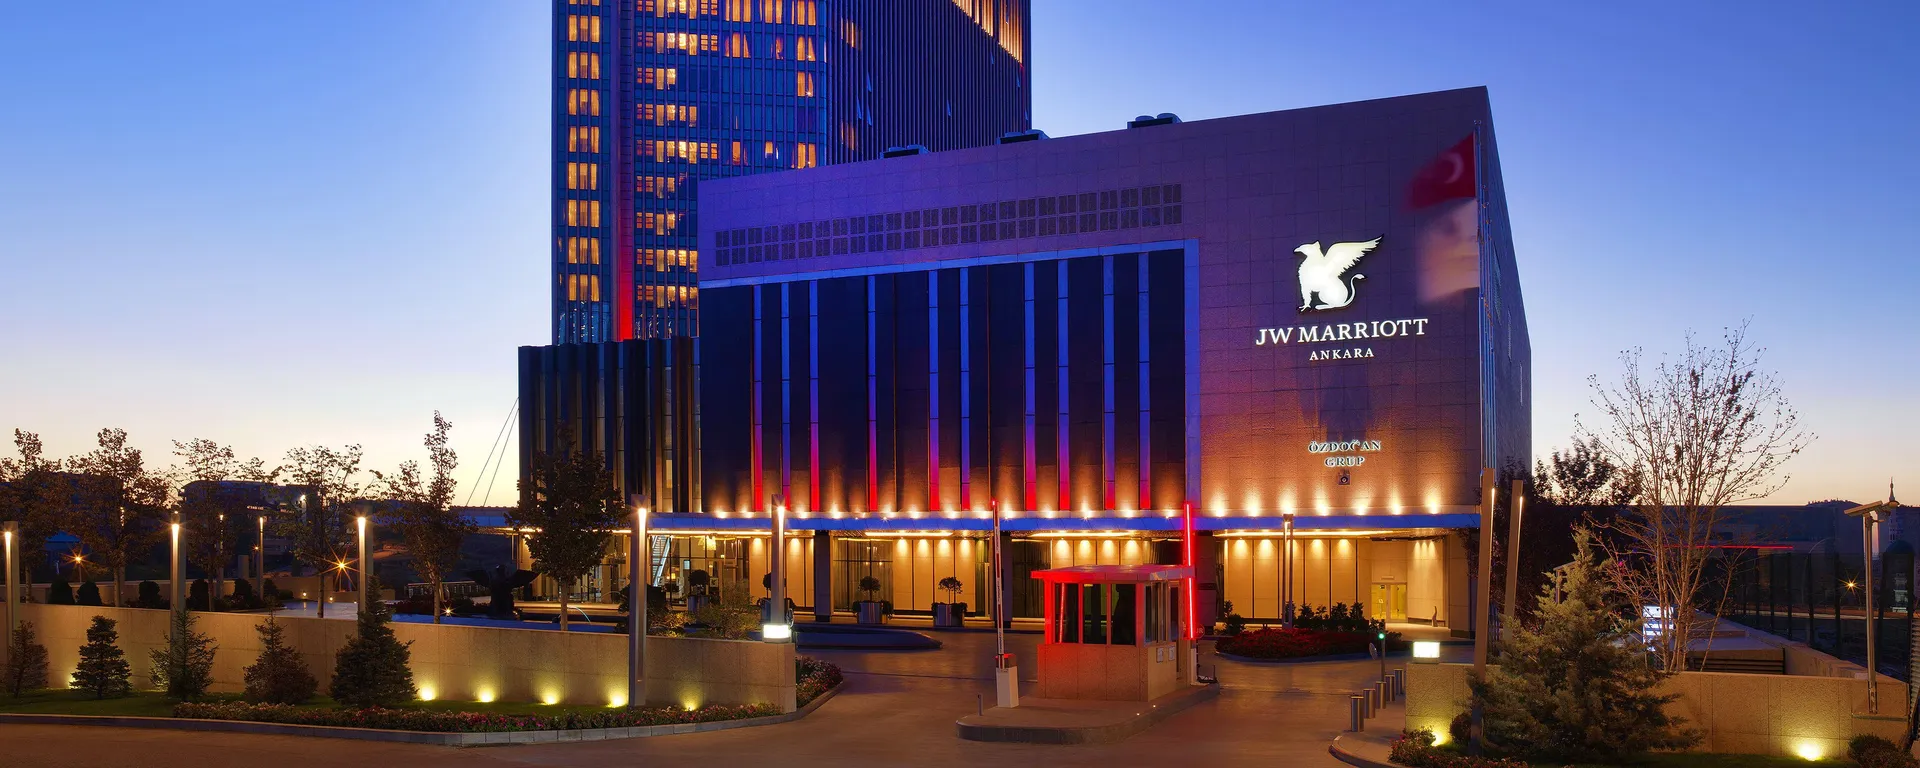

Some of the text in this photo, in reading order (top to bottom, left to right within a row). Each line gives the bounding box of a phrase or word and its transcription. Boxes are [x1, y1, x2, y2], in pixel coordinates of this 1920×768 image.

[1256, 318, 1428, 345] JW MARRIOTT
[1309, 348, 1375, 361] ANKARA
[1324, 456, 1366, 468] GRUP
